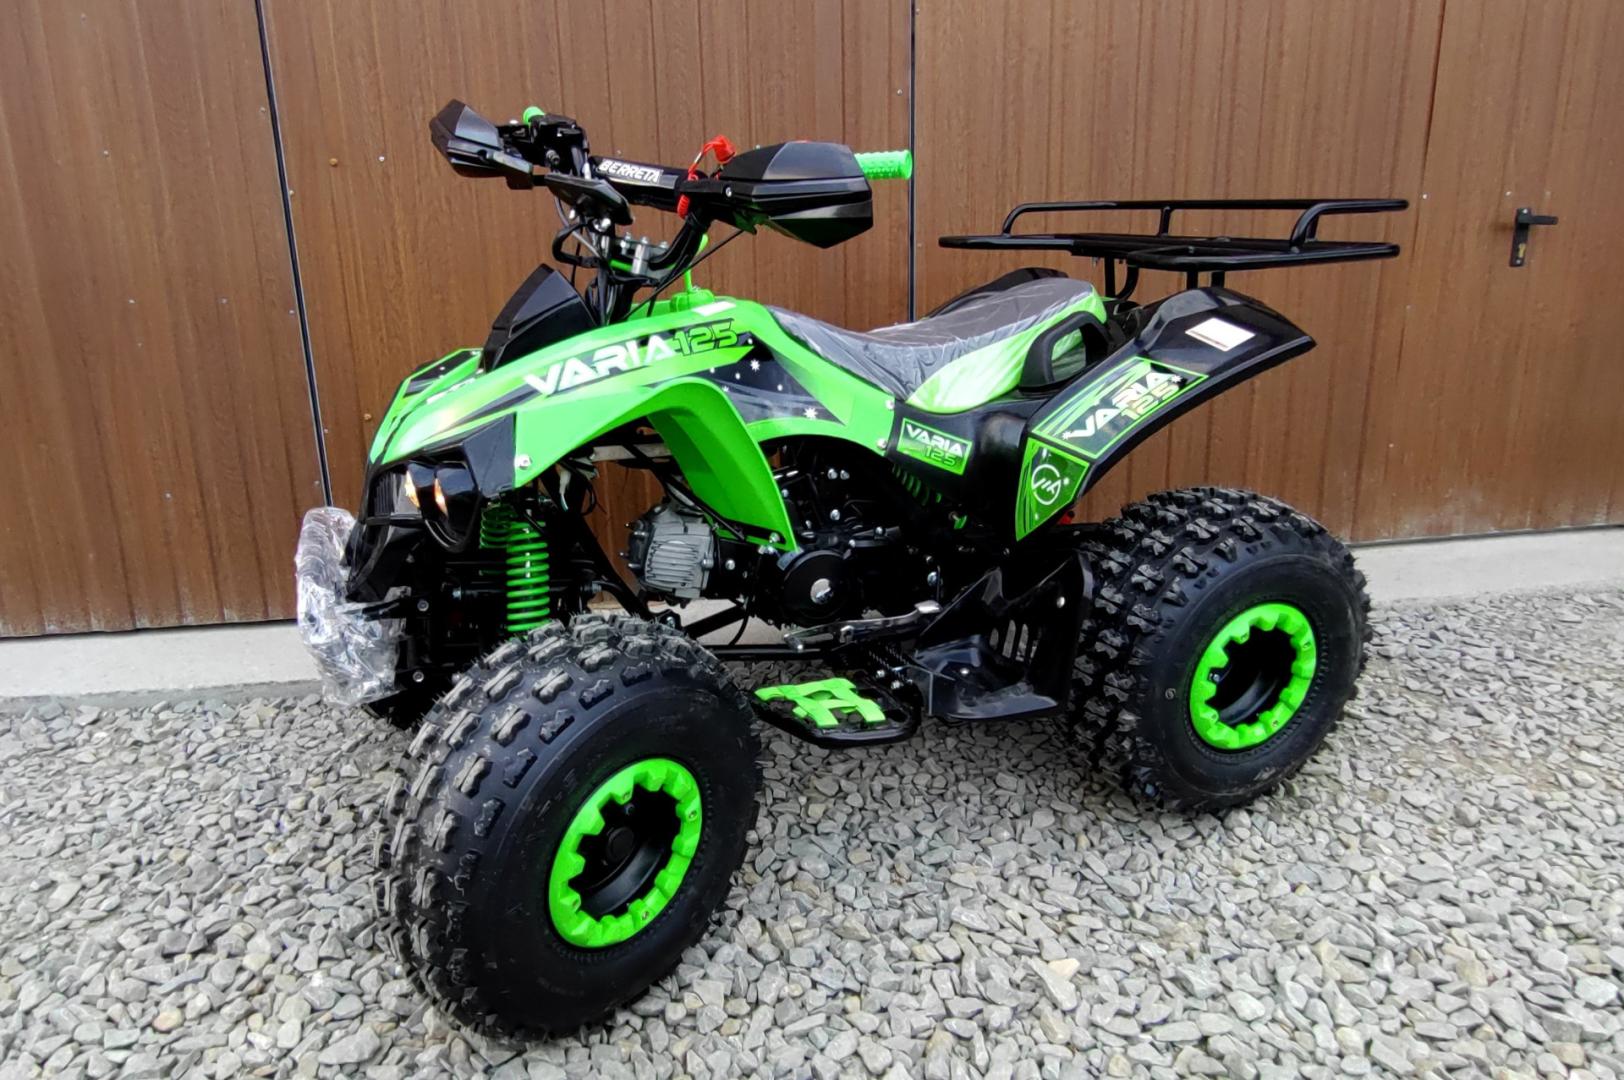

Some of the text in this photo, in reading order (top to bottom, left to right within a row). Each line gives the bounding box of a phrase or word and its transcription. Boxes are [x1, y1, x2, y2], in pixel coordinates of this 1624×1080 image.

[598, 158, 662, 183] BERRETA
[523, 334, 677, 396] VARIA
[673, 318, 738, 356] 125
[1067, 372, 1172, 438] VARIA
[1121, 381, 1180, 421] 125
[906, 423, 963, 458] VARIA
[926, 445, 956, 466] 125
